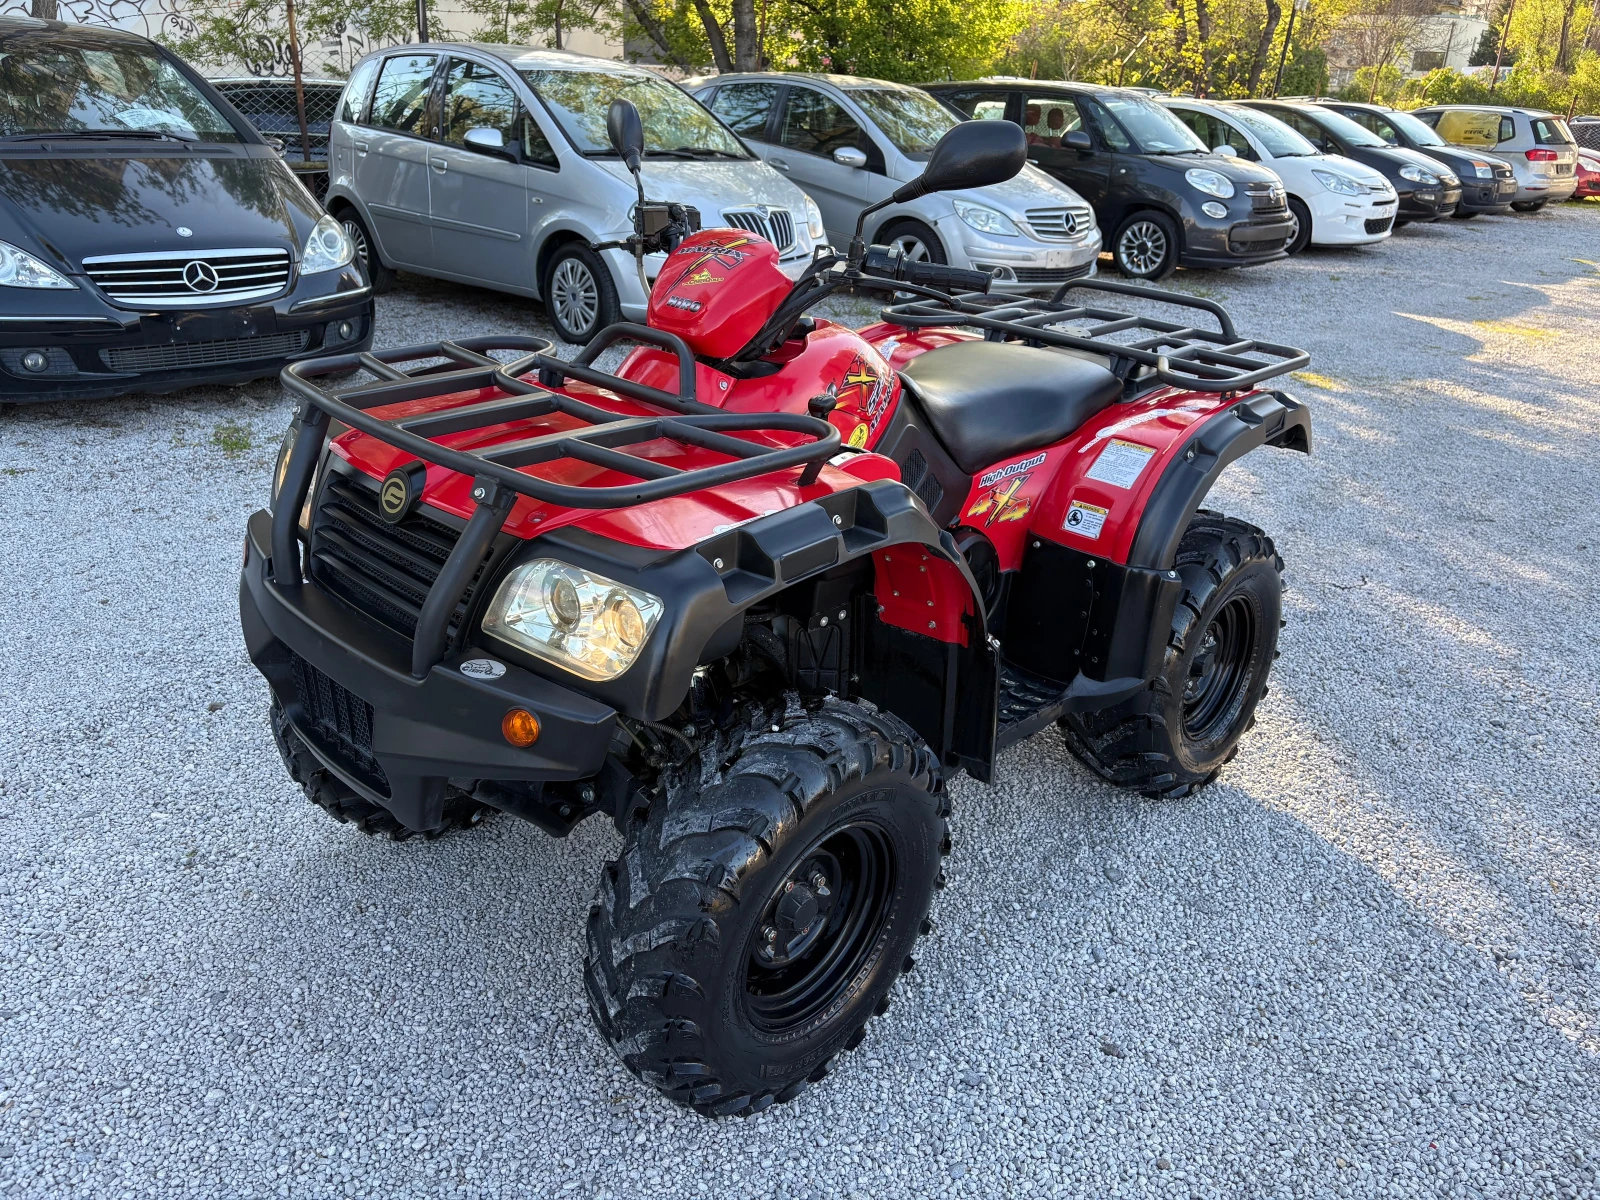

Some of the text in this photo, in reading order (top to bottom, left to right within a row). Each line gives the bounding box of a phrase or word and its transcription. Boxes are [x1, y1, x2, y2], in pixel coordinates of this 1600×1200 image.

[677, 246, 744, 260] MATRIX
[980, 454, 1045, 487] High Output
